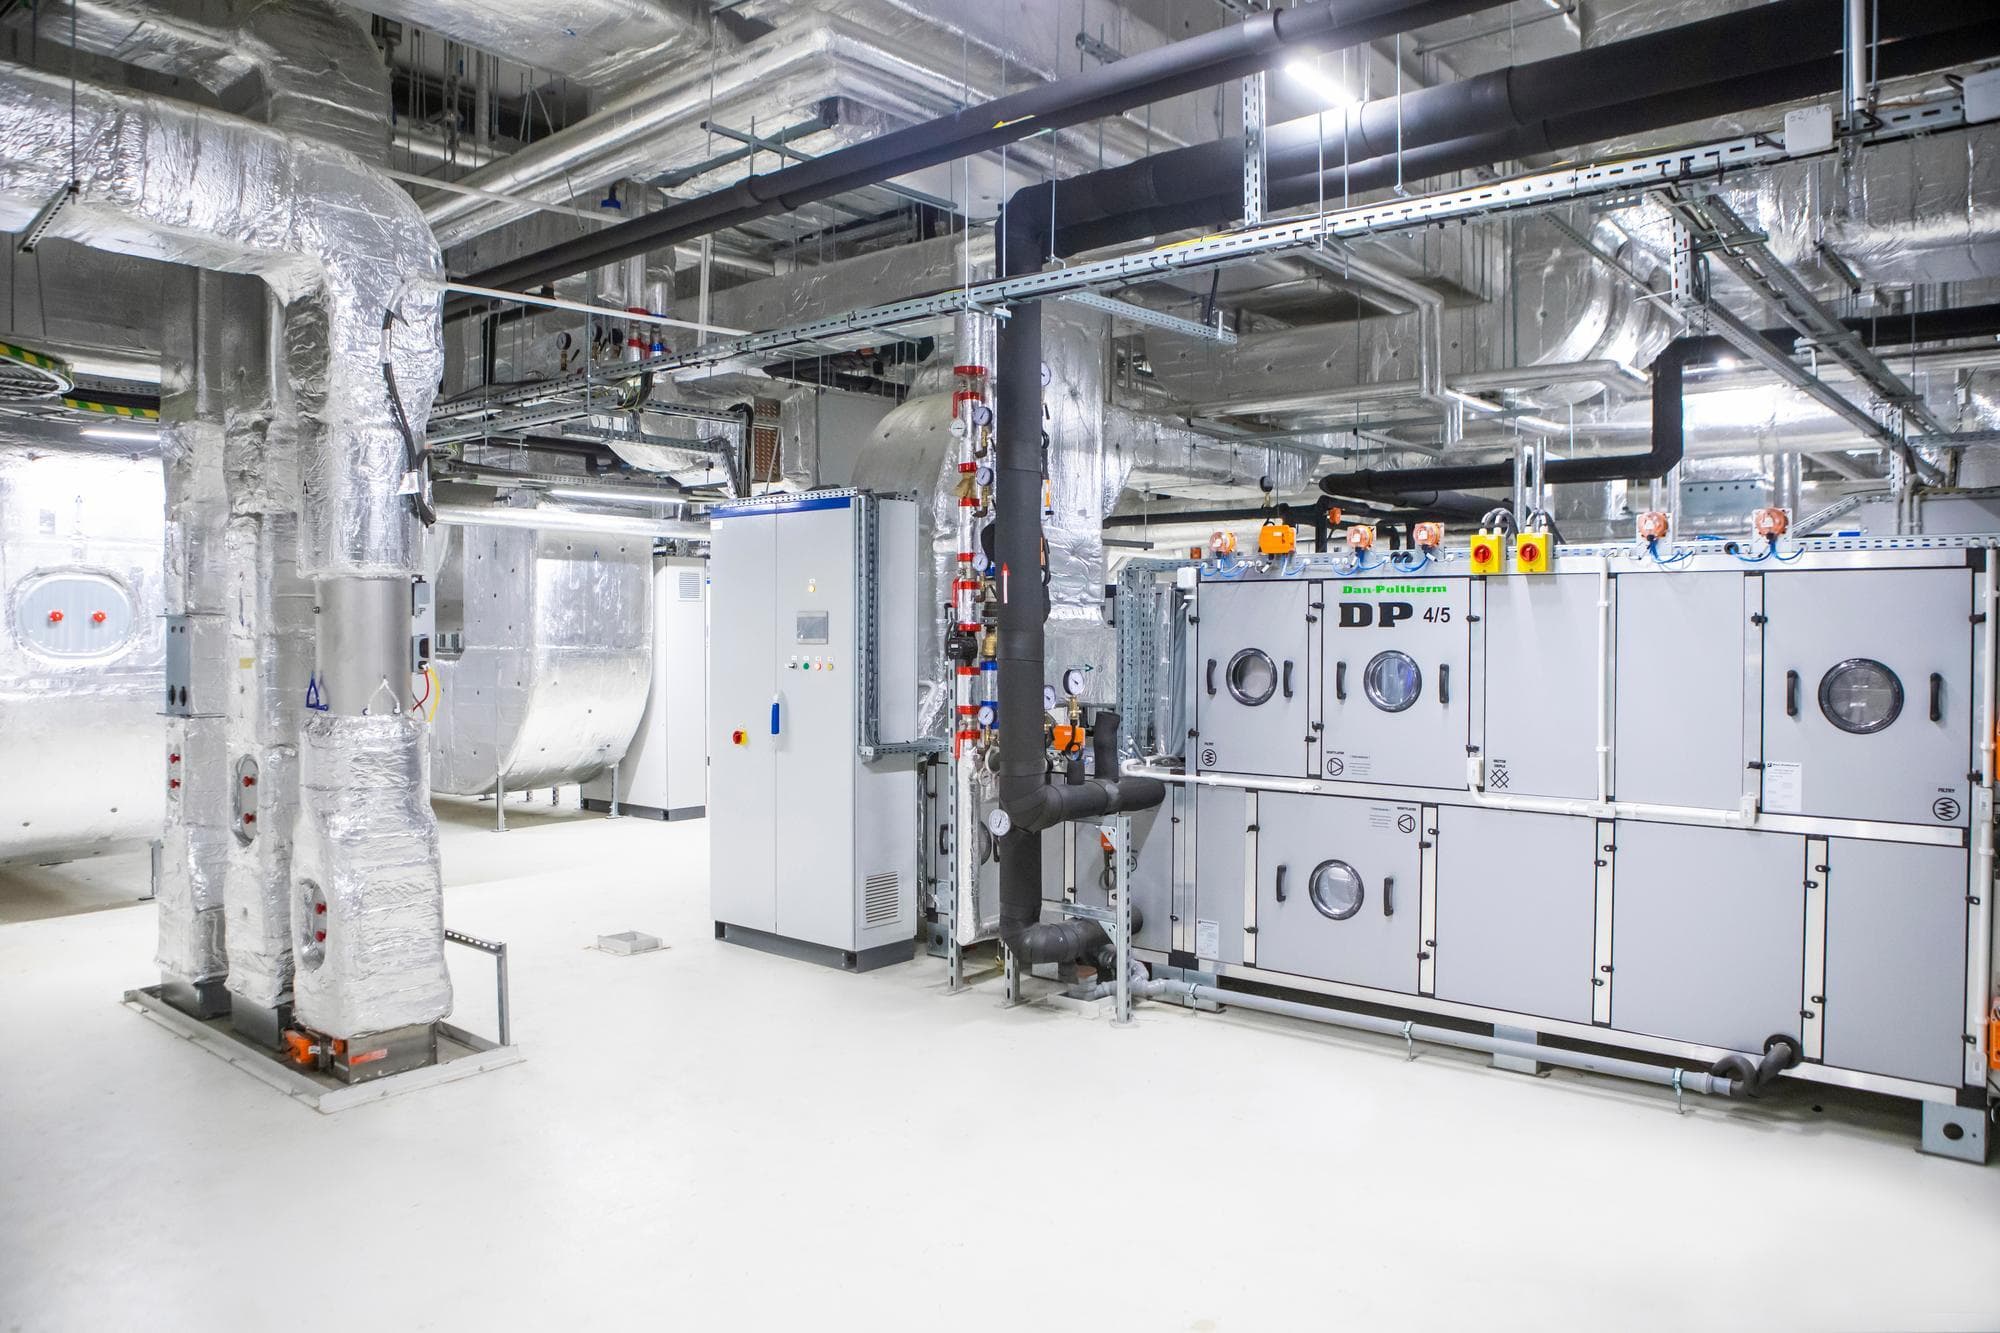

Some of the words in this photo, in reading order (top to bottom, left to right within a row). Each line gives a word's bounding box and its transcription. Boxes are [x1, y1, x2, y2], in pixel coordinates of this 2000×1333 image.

[1342, 585, 1447, 594] Dan-Poltherm
[1339, 602, 1414, 627] DP
[1423, 607, 1450, 623] 4/5
